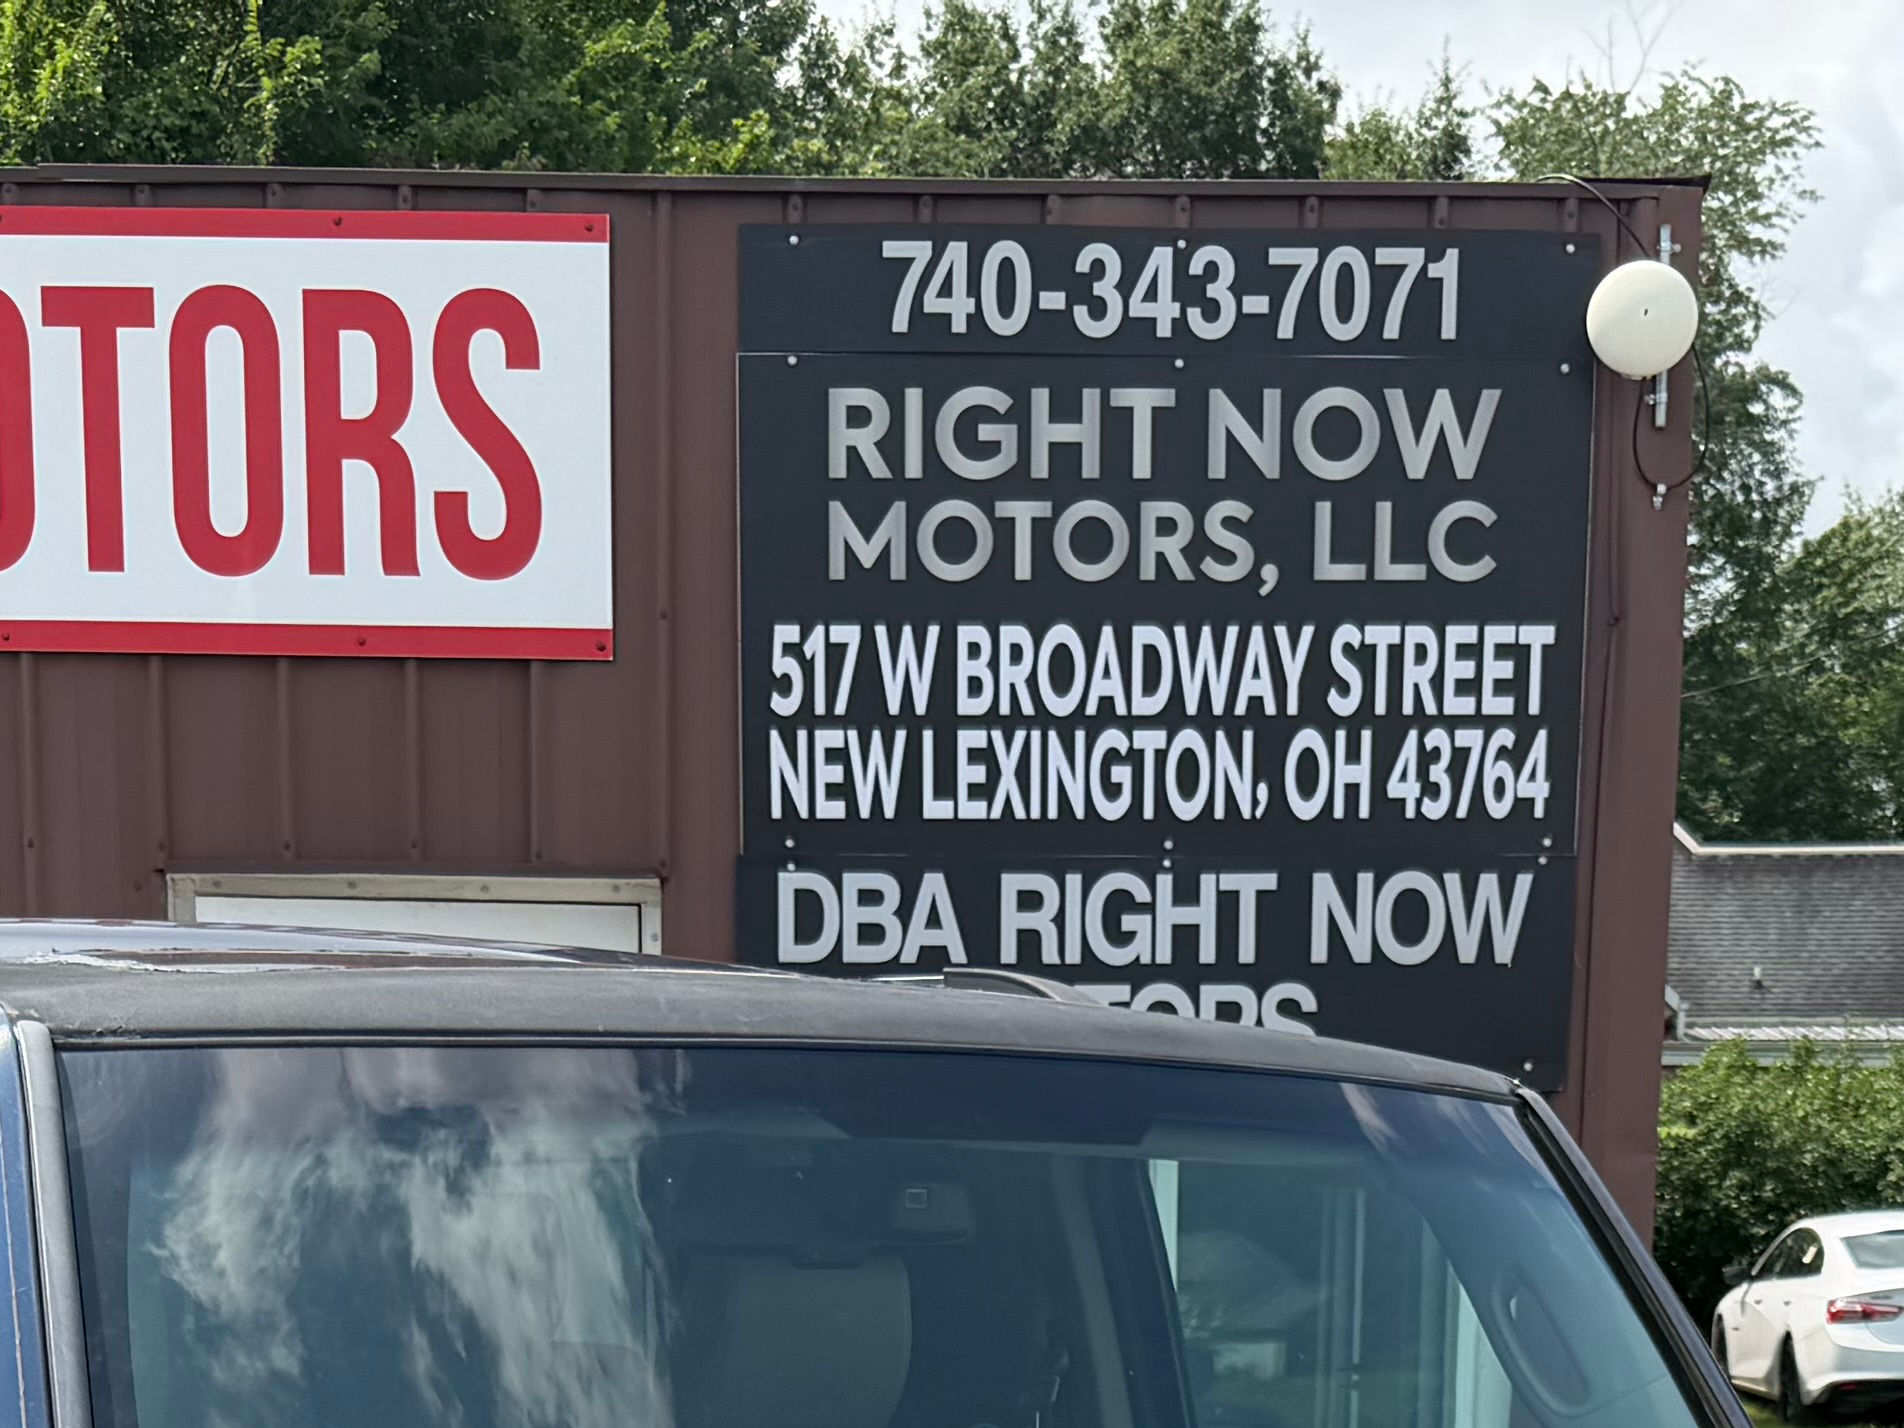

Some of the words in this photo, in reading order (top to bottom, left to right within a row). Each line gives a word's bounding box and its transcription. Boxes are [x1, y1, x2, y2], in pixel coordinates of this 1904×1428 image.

[882, 239, 1460, 342] 740-343-7071
[828, 386, 1176, 480] RIGHT
[1207, 387, 1502, 480] NOW
[828, 500, 1279, 597] MOTORS,
[1313, 500, 1498, 582] LLC
[769, 624, 862, 717] 517
[874, 624, 941, 716] W
[956, 623, 1316, 717] BROADWAY
[1326, 623, 1556, 717] STREET
[769, 728, 907, 820] NEW
[922, 727, 1269, 822] LEXINGTON,
[1284, 727, 1373, 821] OH
[1386, 727, 1551, 821] 43764
[778, 872, 968, 966] DBA
[1000, 872, 1278, 967] RIGHT
[1310, 871, 1534, 967] NOW
